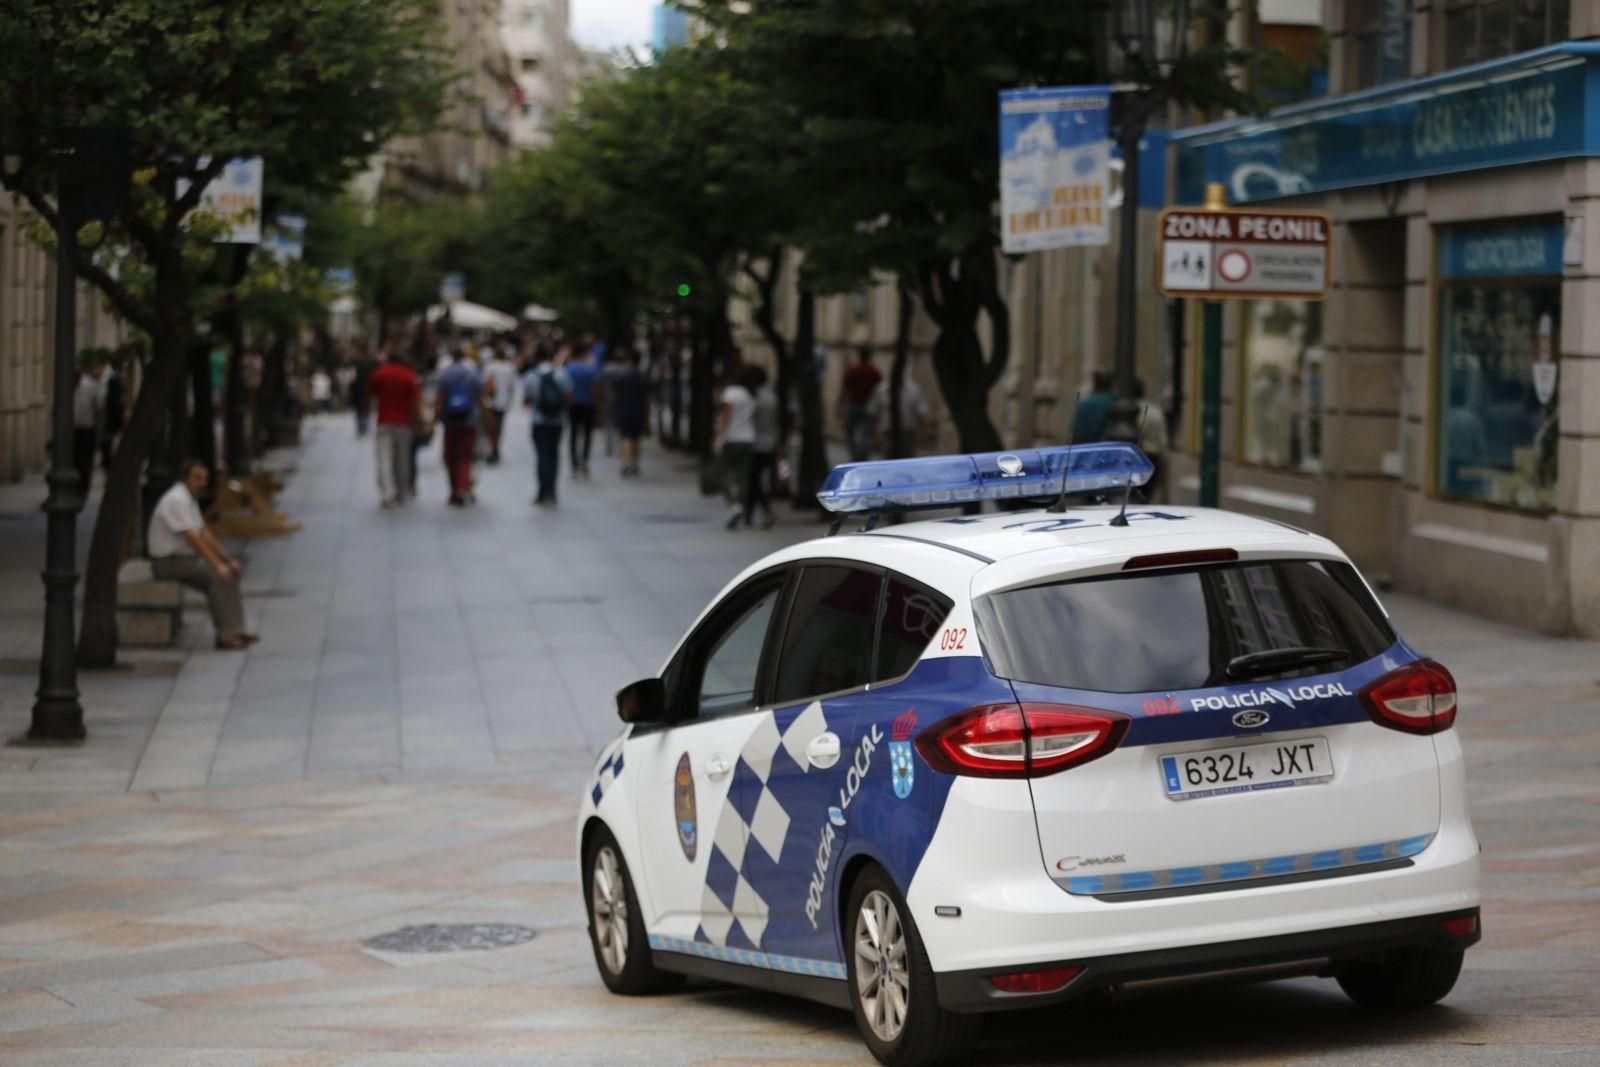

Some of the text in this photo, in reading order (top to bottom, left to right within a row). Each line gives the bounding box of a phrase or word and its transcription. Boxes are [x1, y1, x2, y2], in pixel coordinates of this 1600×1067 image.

[1165, 215, 1327, 241] ZONA PEONIL
[941, 628, 967, 650] 092
[1143, 697, 1180, 716] 092
[1191, 682, 1353, 712] POLICÍA LOCAL
[1185, 744, 1315, 785] 6324 JXT
[805, 723, 884, 929] POLICÍA LOCAL
